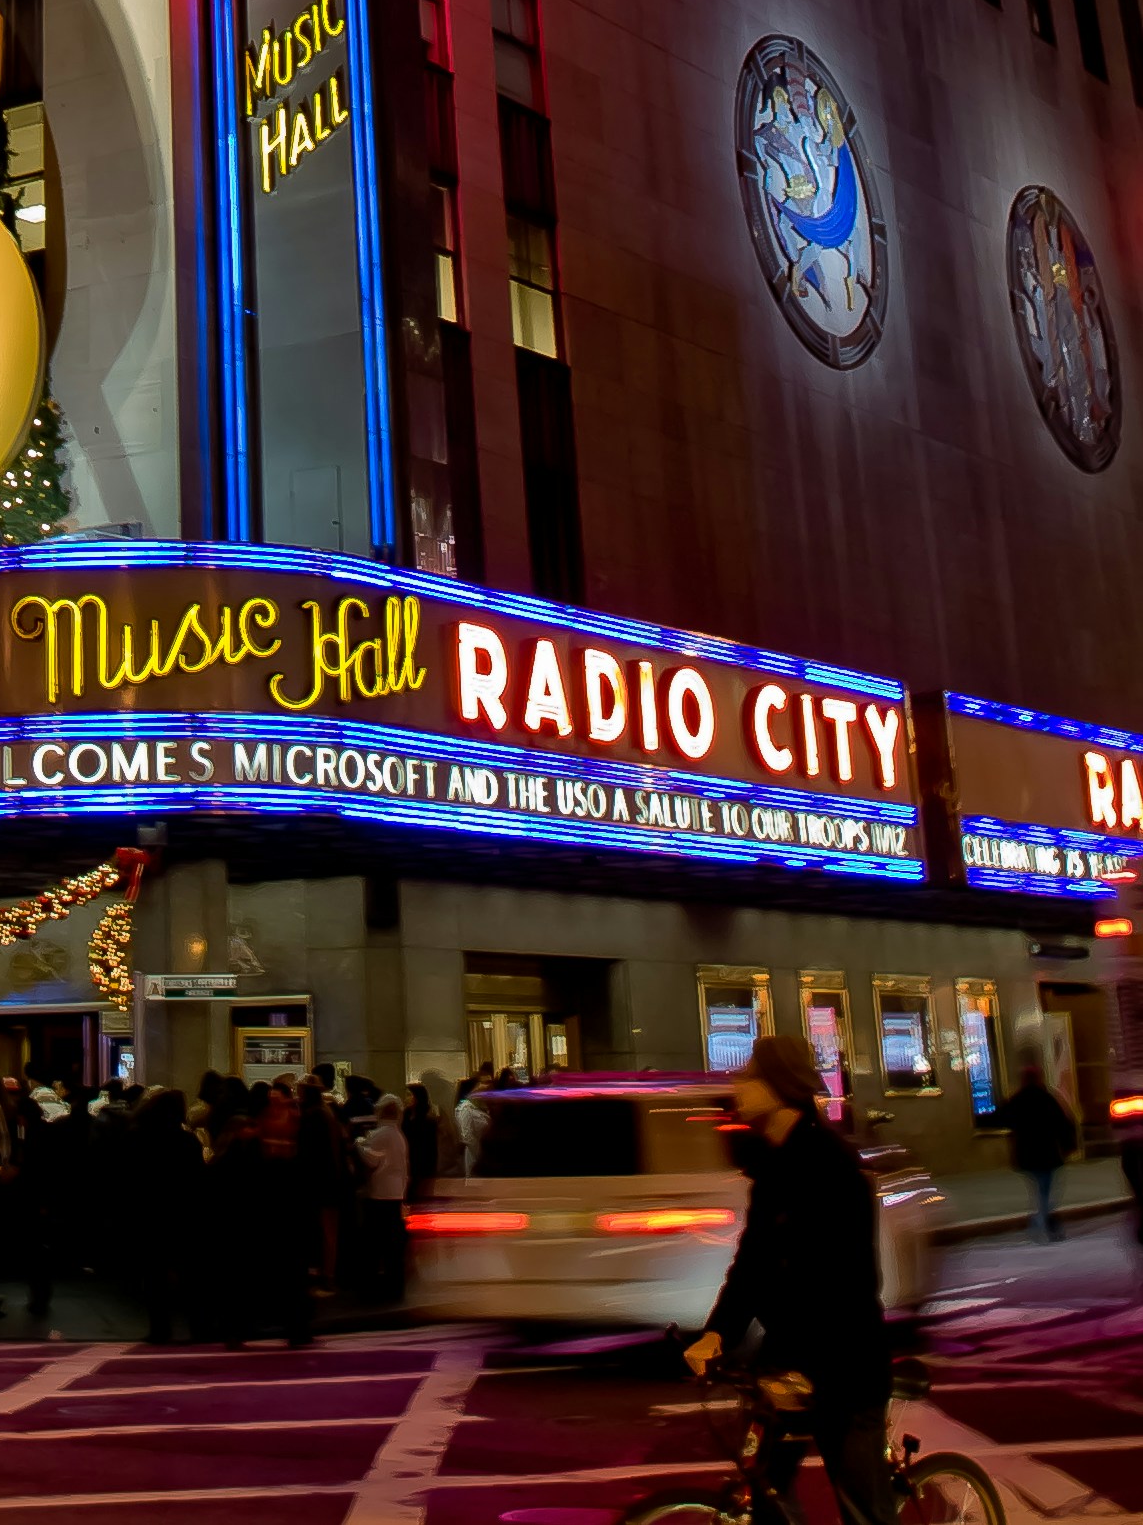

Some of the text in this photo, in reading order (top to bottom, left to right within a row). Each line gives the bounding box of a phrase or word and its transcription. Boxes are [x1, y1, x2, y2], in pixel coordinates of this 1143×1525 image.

[260, 87, 349, 194] HALL
[11, 593, 427, 710] Music Hall
[458, 621, 900, 789] RADIO CITY
[234, 742, 438, 799] MICROSOFT
[448, 764, 499, 806] AND
[504, 772, 550, 812] THE
[556, 778, 607, 818] USO
[612, 787, 631, 823] A
[634, 790, 717, 834] SALUTE
[718, 801, 749, 837] TO
[751, 805, 796, 842] OUR
[795, 811, 870, 852] TROOPS
